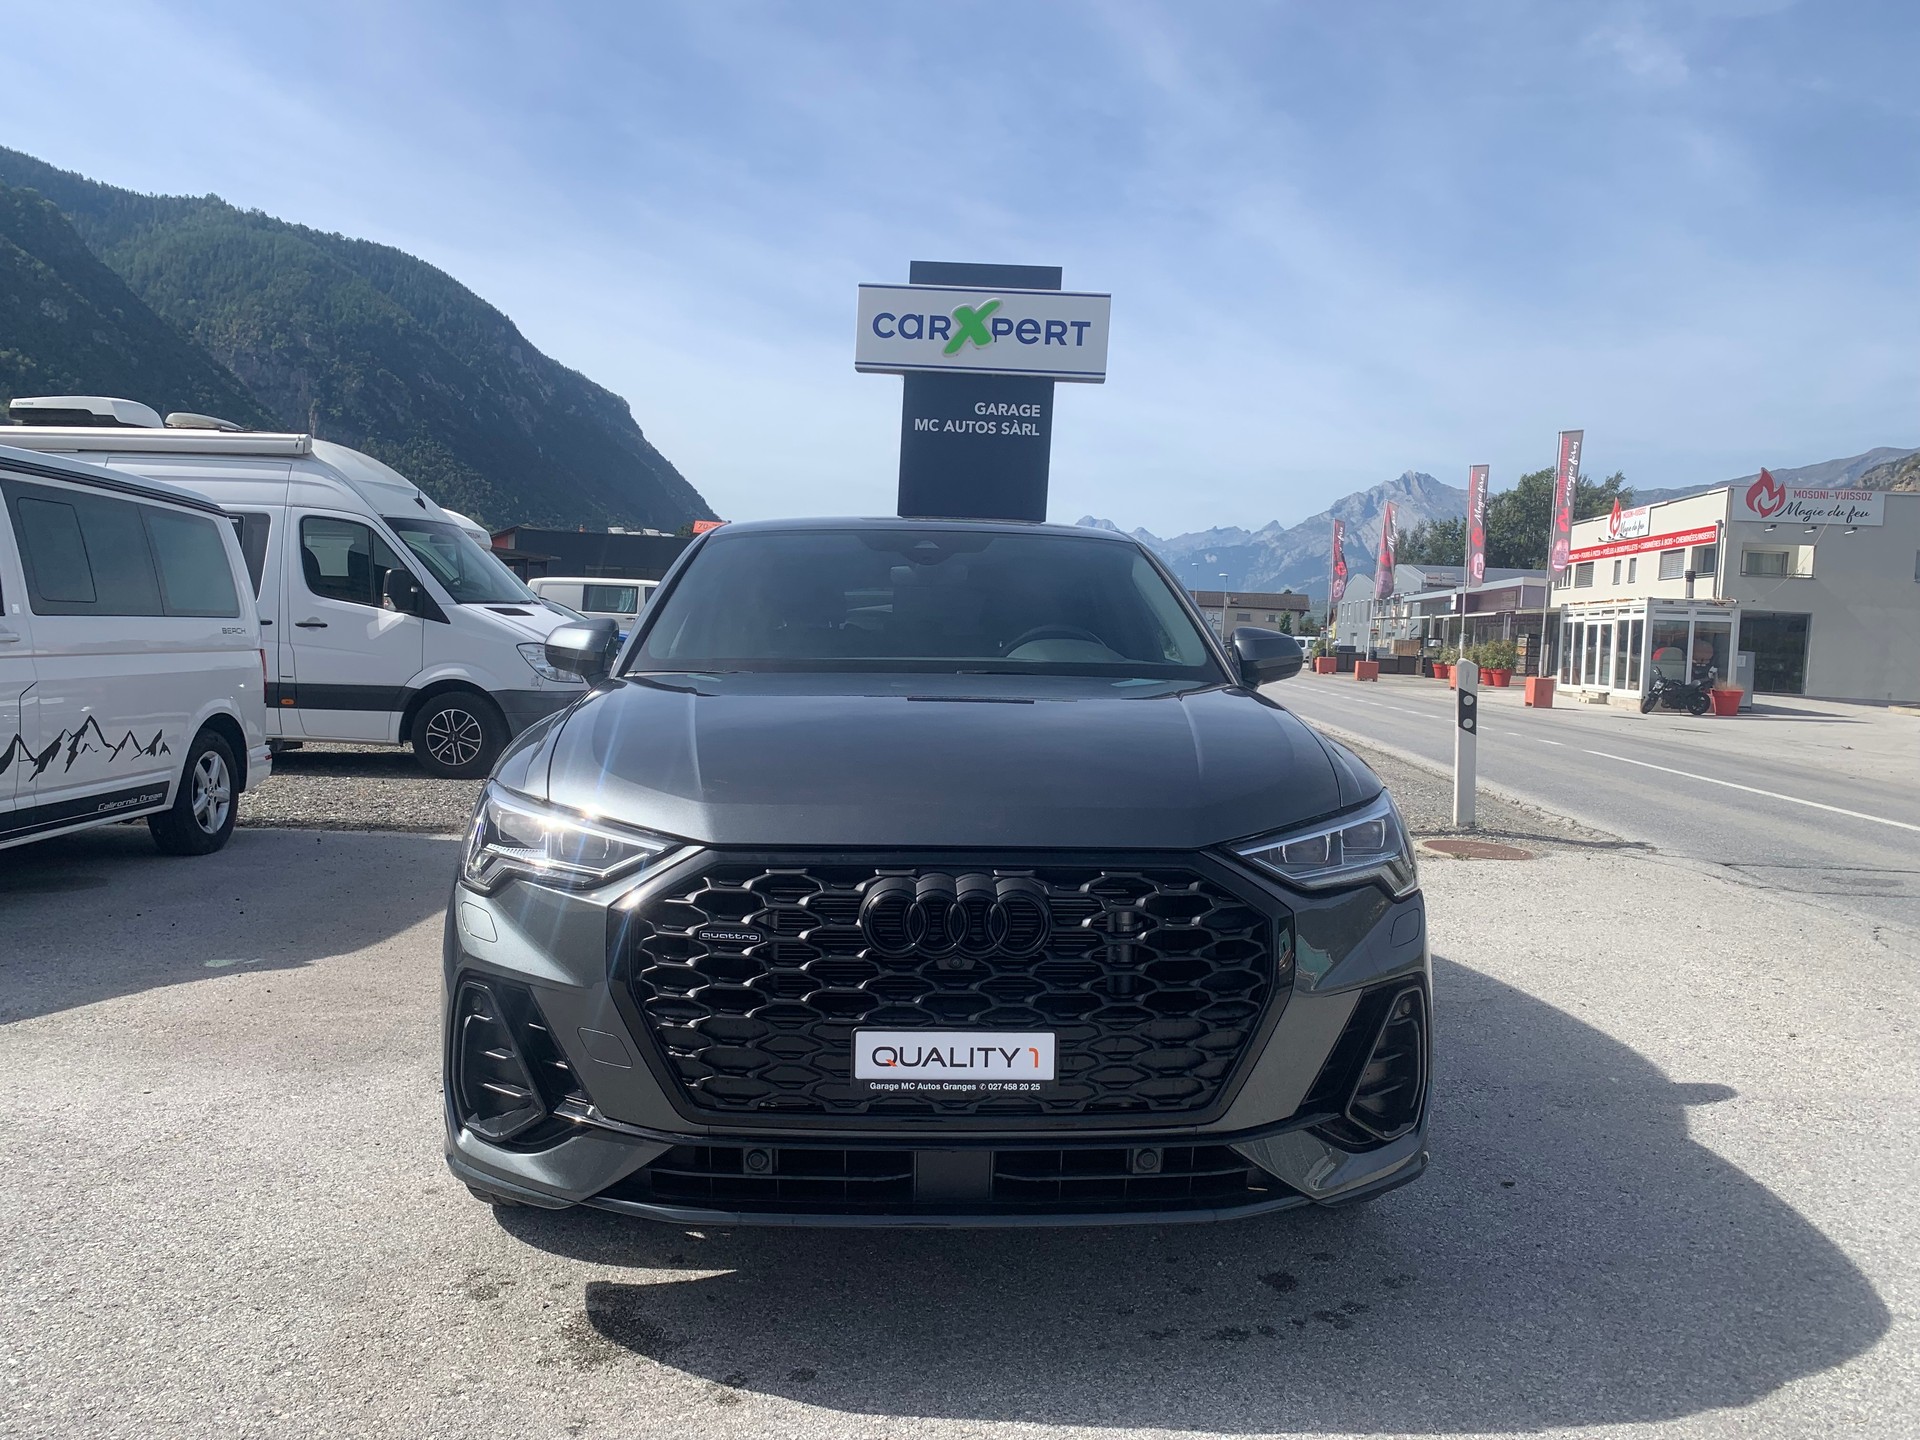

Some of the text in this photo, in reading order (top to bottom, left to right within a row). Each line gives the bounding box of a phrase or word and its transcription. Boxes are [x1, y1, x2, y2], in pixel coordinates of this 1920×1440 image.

[974, 402, 1041, 417] GARAGE
[914, 418, 1040, 436] MC AUTOS SÀRL
[1794, 490, 1872, 502] MOSONI-VUISSOZ
[1774, 500, 1870, 524] Magie du feu
[98, 793, 163, 811] California Dream
[872, 1046, 1038, 1068] QUALITY 1
[870, 1082, 899, 1091] Garage
[943, 1083, 976, 1091] Granges
